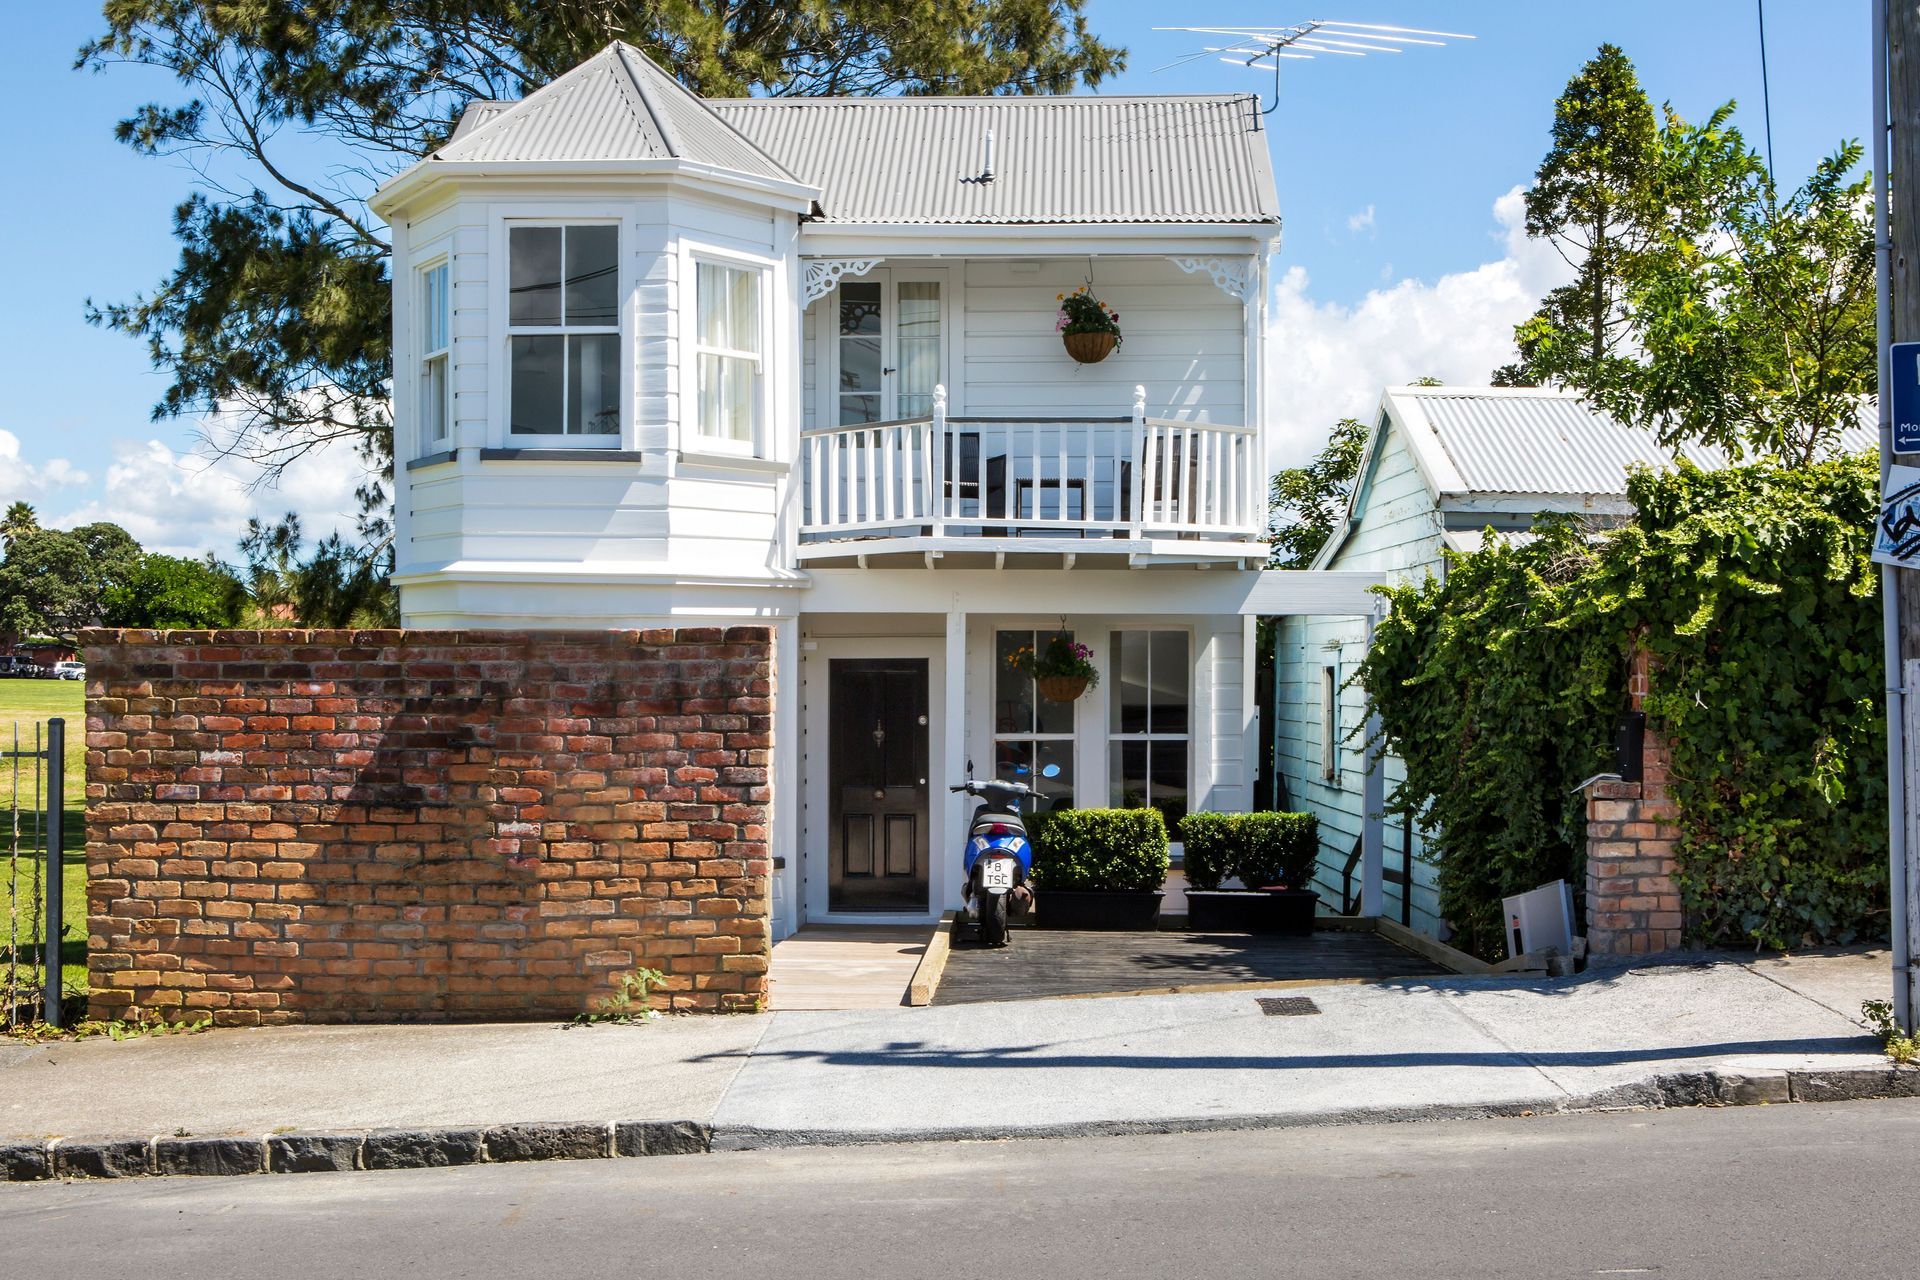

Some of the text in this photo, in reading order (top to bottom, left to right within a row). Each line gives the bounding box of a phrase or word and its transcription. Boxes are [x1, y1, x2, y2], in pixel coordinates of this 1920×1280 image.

[1900, 422, 1920, 432] Mo
[994, 862, 1002, 872] 8
[987, 874, 1008, 885] TSC
